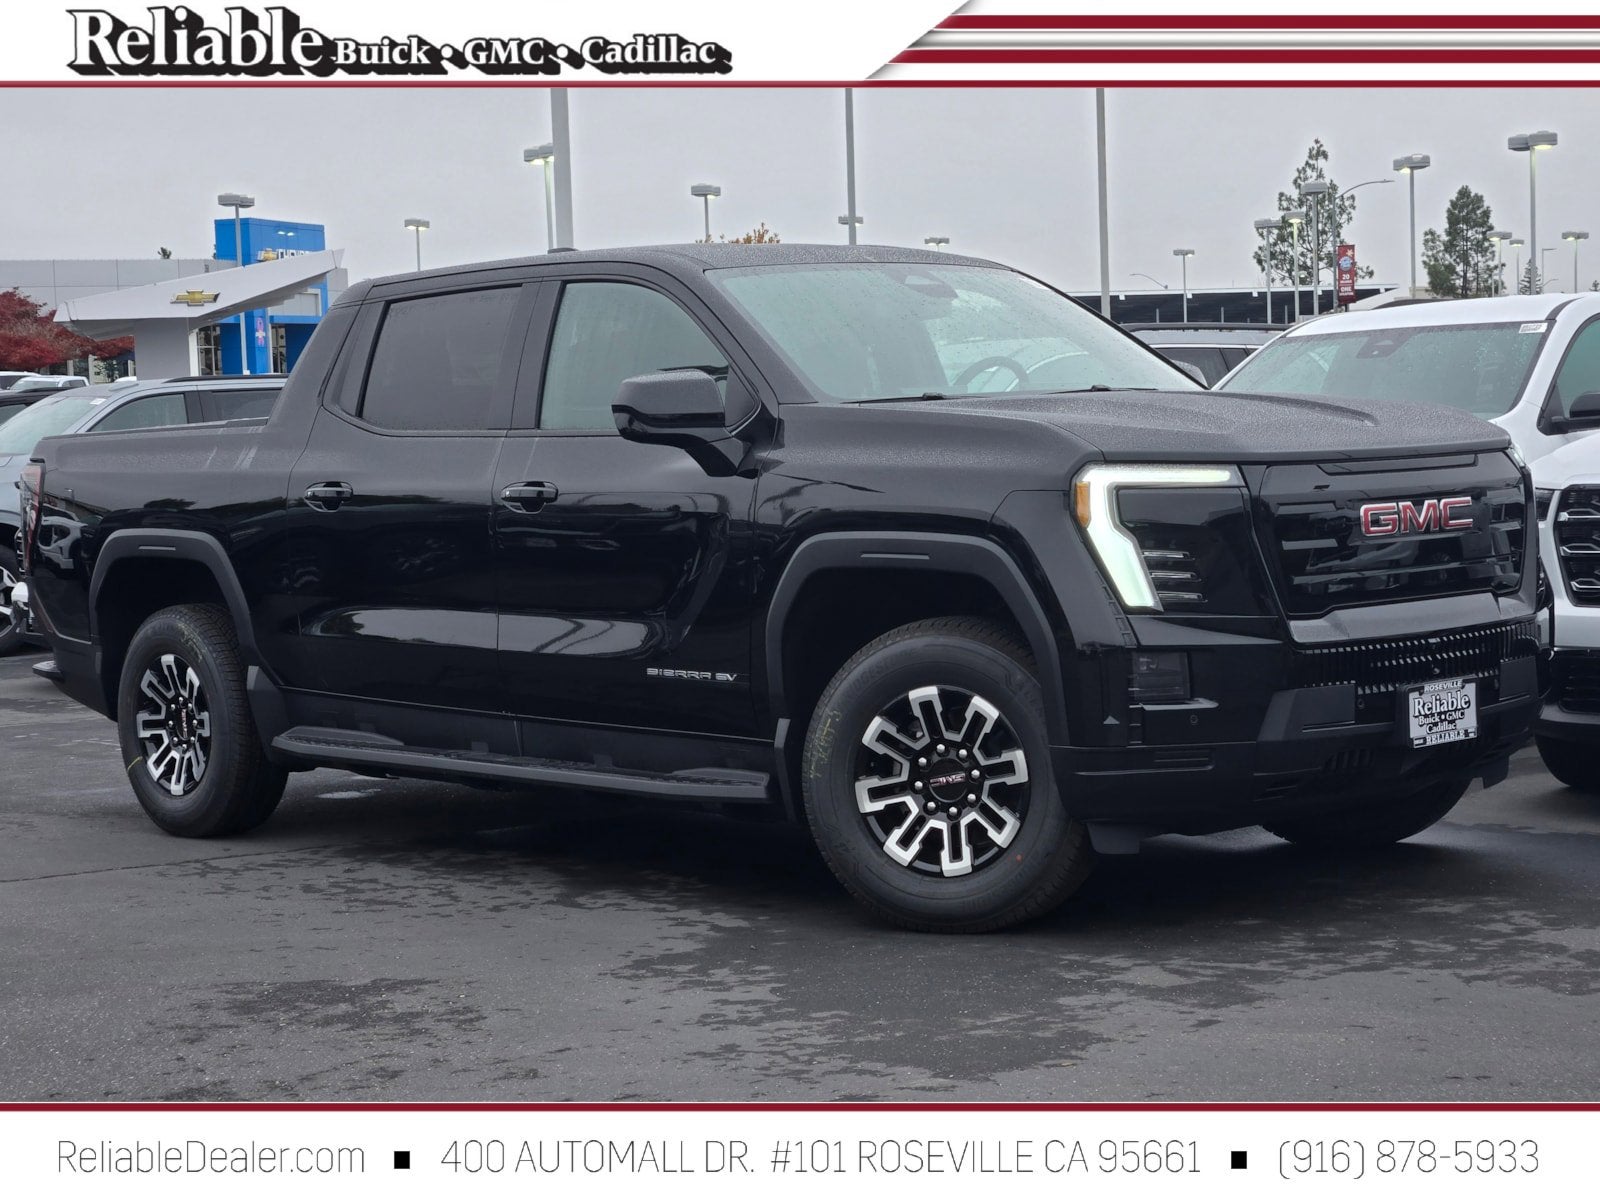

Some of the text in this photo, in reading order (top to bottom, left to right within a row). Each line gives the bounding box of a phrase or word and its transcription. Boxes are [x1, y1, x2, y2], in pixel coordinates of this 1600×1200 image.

[1360, 496, 1473, 536] GMC
[646, 667, 738, 682] SIERRA EV
[1424, 680, 1463, 691] ROSEVILLE
[1413, 691, 1470, 717] Reliable
[1418, 711, 1465, 727] Buick GMC
[1426, 721, 1456, 734] Cadillac
[1425, 731, 1465, 744] RELIABLE
